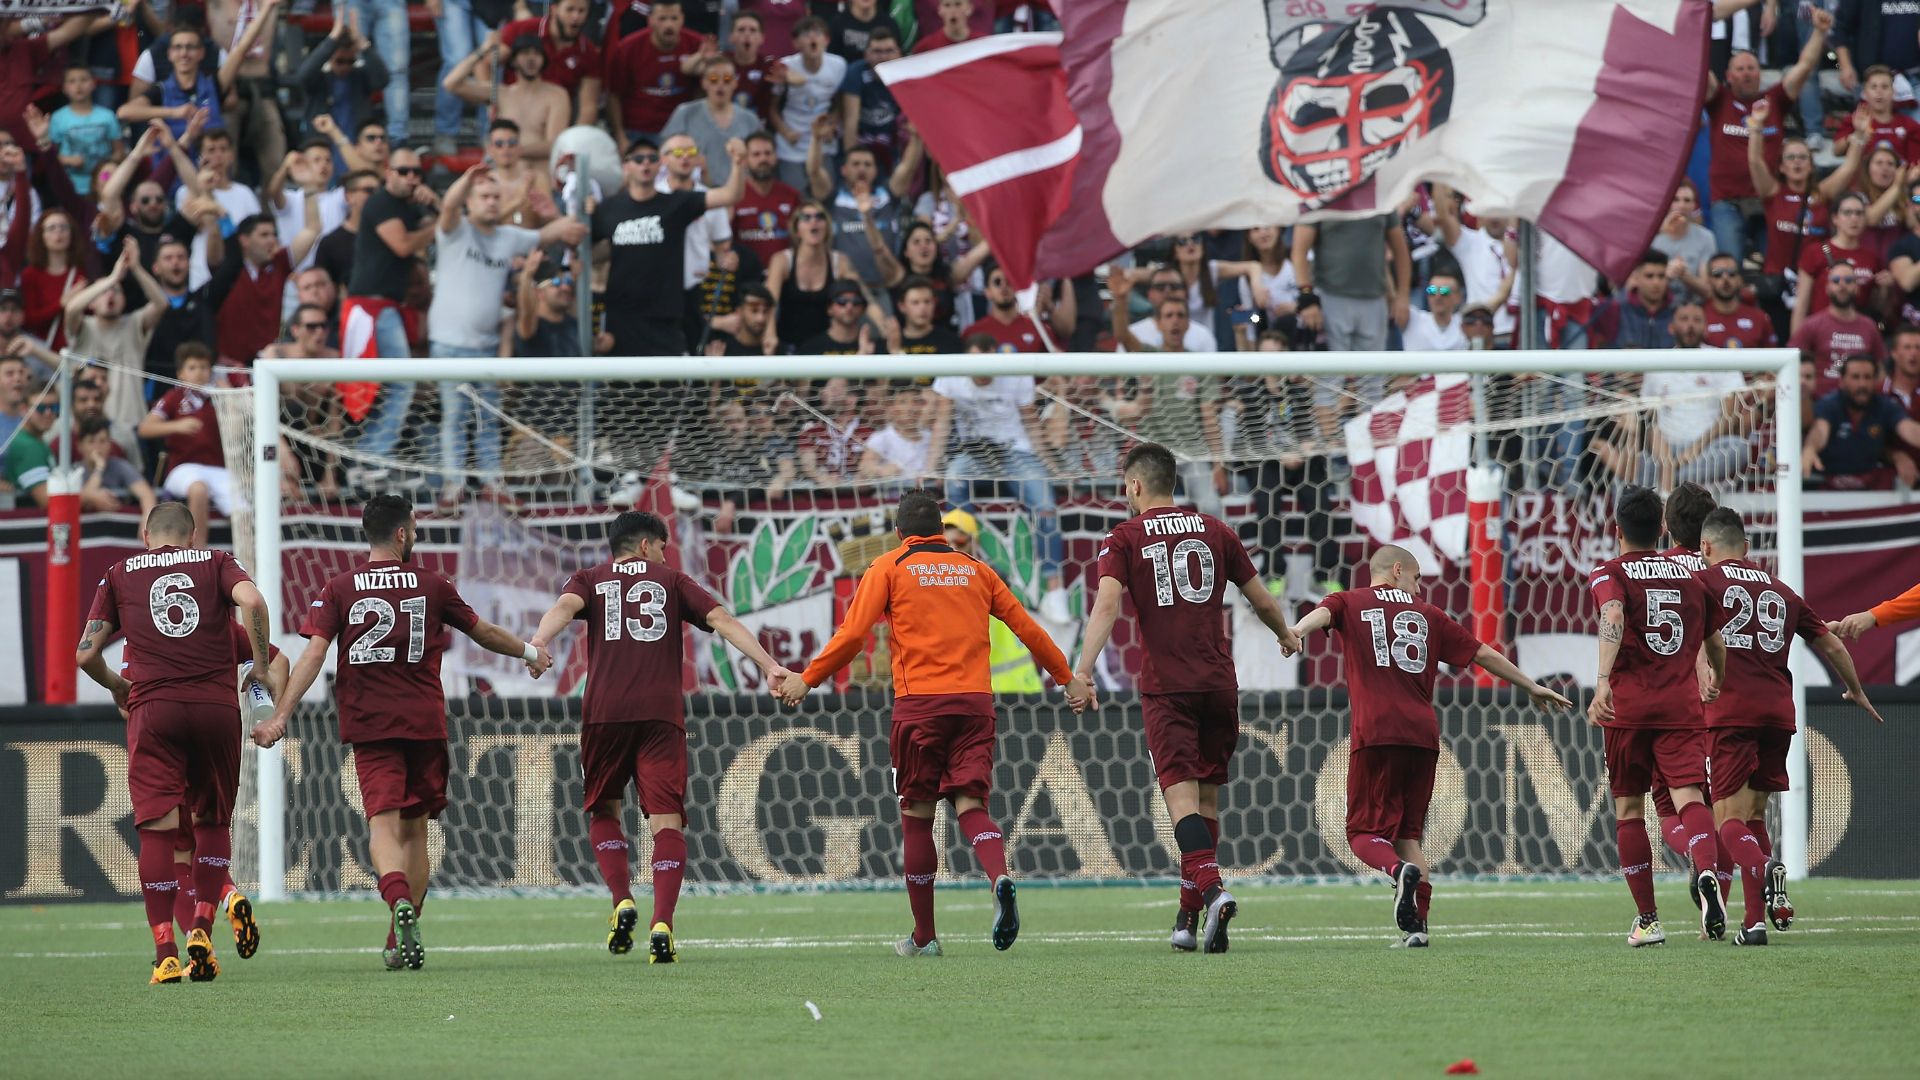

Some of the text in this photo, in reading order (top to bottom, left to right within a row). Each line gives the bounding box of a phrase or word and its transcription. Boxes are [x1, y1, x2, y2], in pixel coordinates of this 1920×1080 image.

[125, 549, 213, 573] SCOGNAMIGLIO
[353, 572, 418, 591] NIZZETTO
[906, 563, 976, 576] TRAPANI
[919, 576, 969, 587] CALCIO
[1141, 538, 1215, 607] 10
[1720, 565, 1772, 585] RIZZATO
[149, 572, 200, 638] 6
[348, 595, 427, 665] 21
[595, 579, 668, 642] 13
[1645, 588, 1684, 656] 5
[1720, 585, 1787, 653] 29
[1360, 607, 1429, 674] 18
